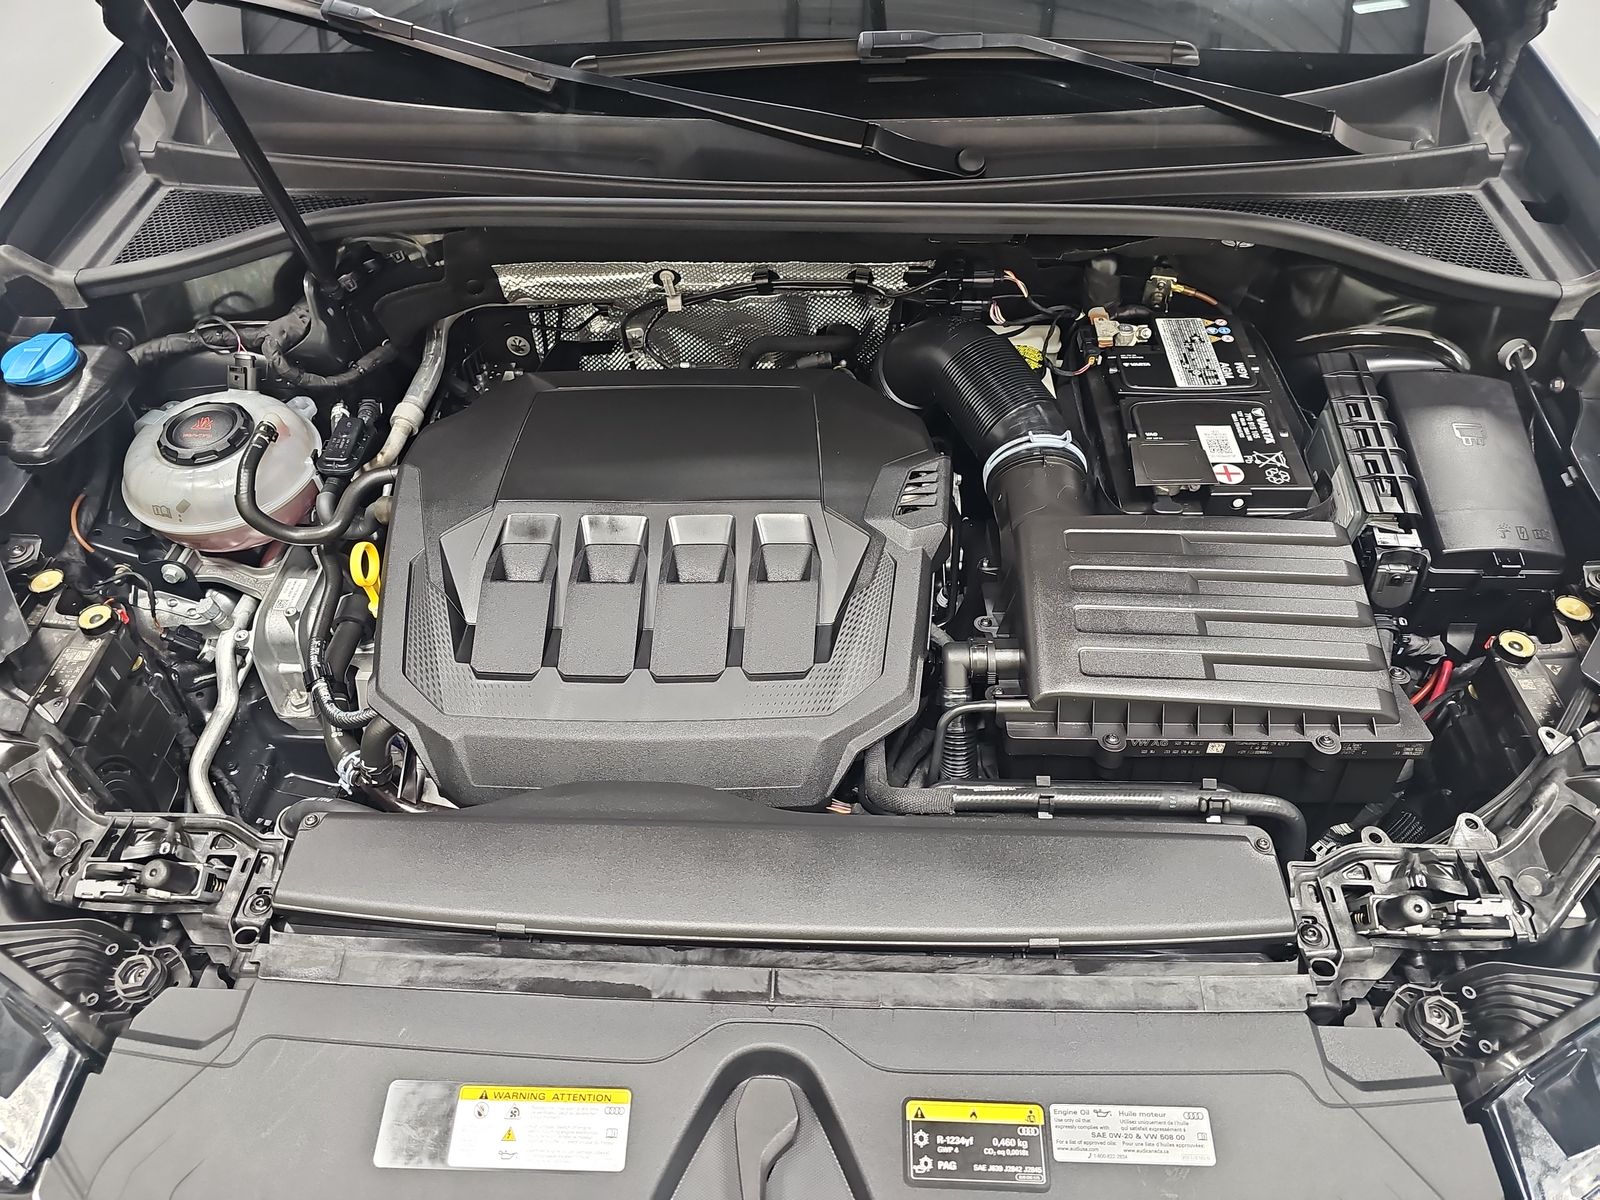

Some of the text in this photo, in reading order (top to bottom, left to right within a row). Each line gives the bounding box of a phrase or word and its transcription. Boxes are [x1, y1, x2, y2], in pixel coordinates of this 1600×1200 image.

[1219, 362, 1234, 379] AGM
[1234, 362, 1250, 379] AGM
[1256, 416, 1276, 445] VARTA
[493, 1091, 612, 1102] WARNING ATTENTION
[936, 1135, 974, 1147] R-1234yf
[1017, 1138, 1028, 1149] kg
[938, 1160, 958, 1170] PAG
[973, 1164, 987, 1172] SAE
